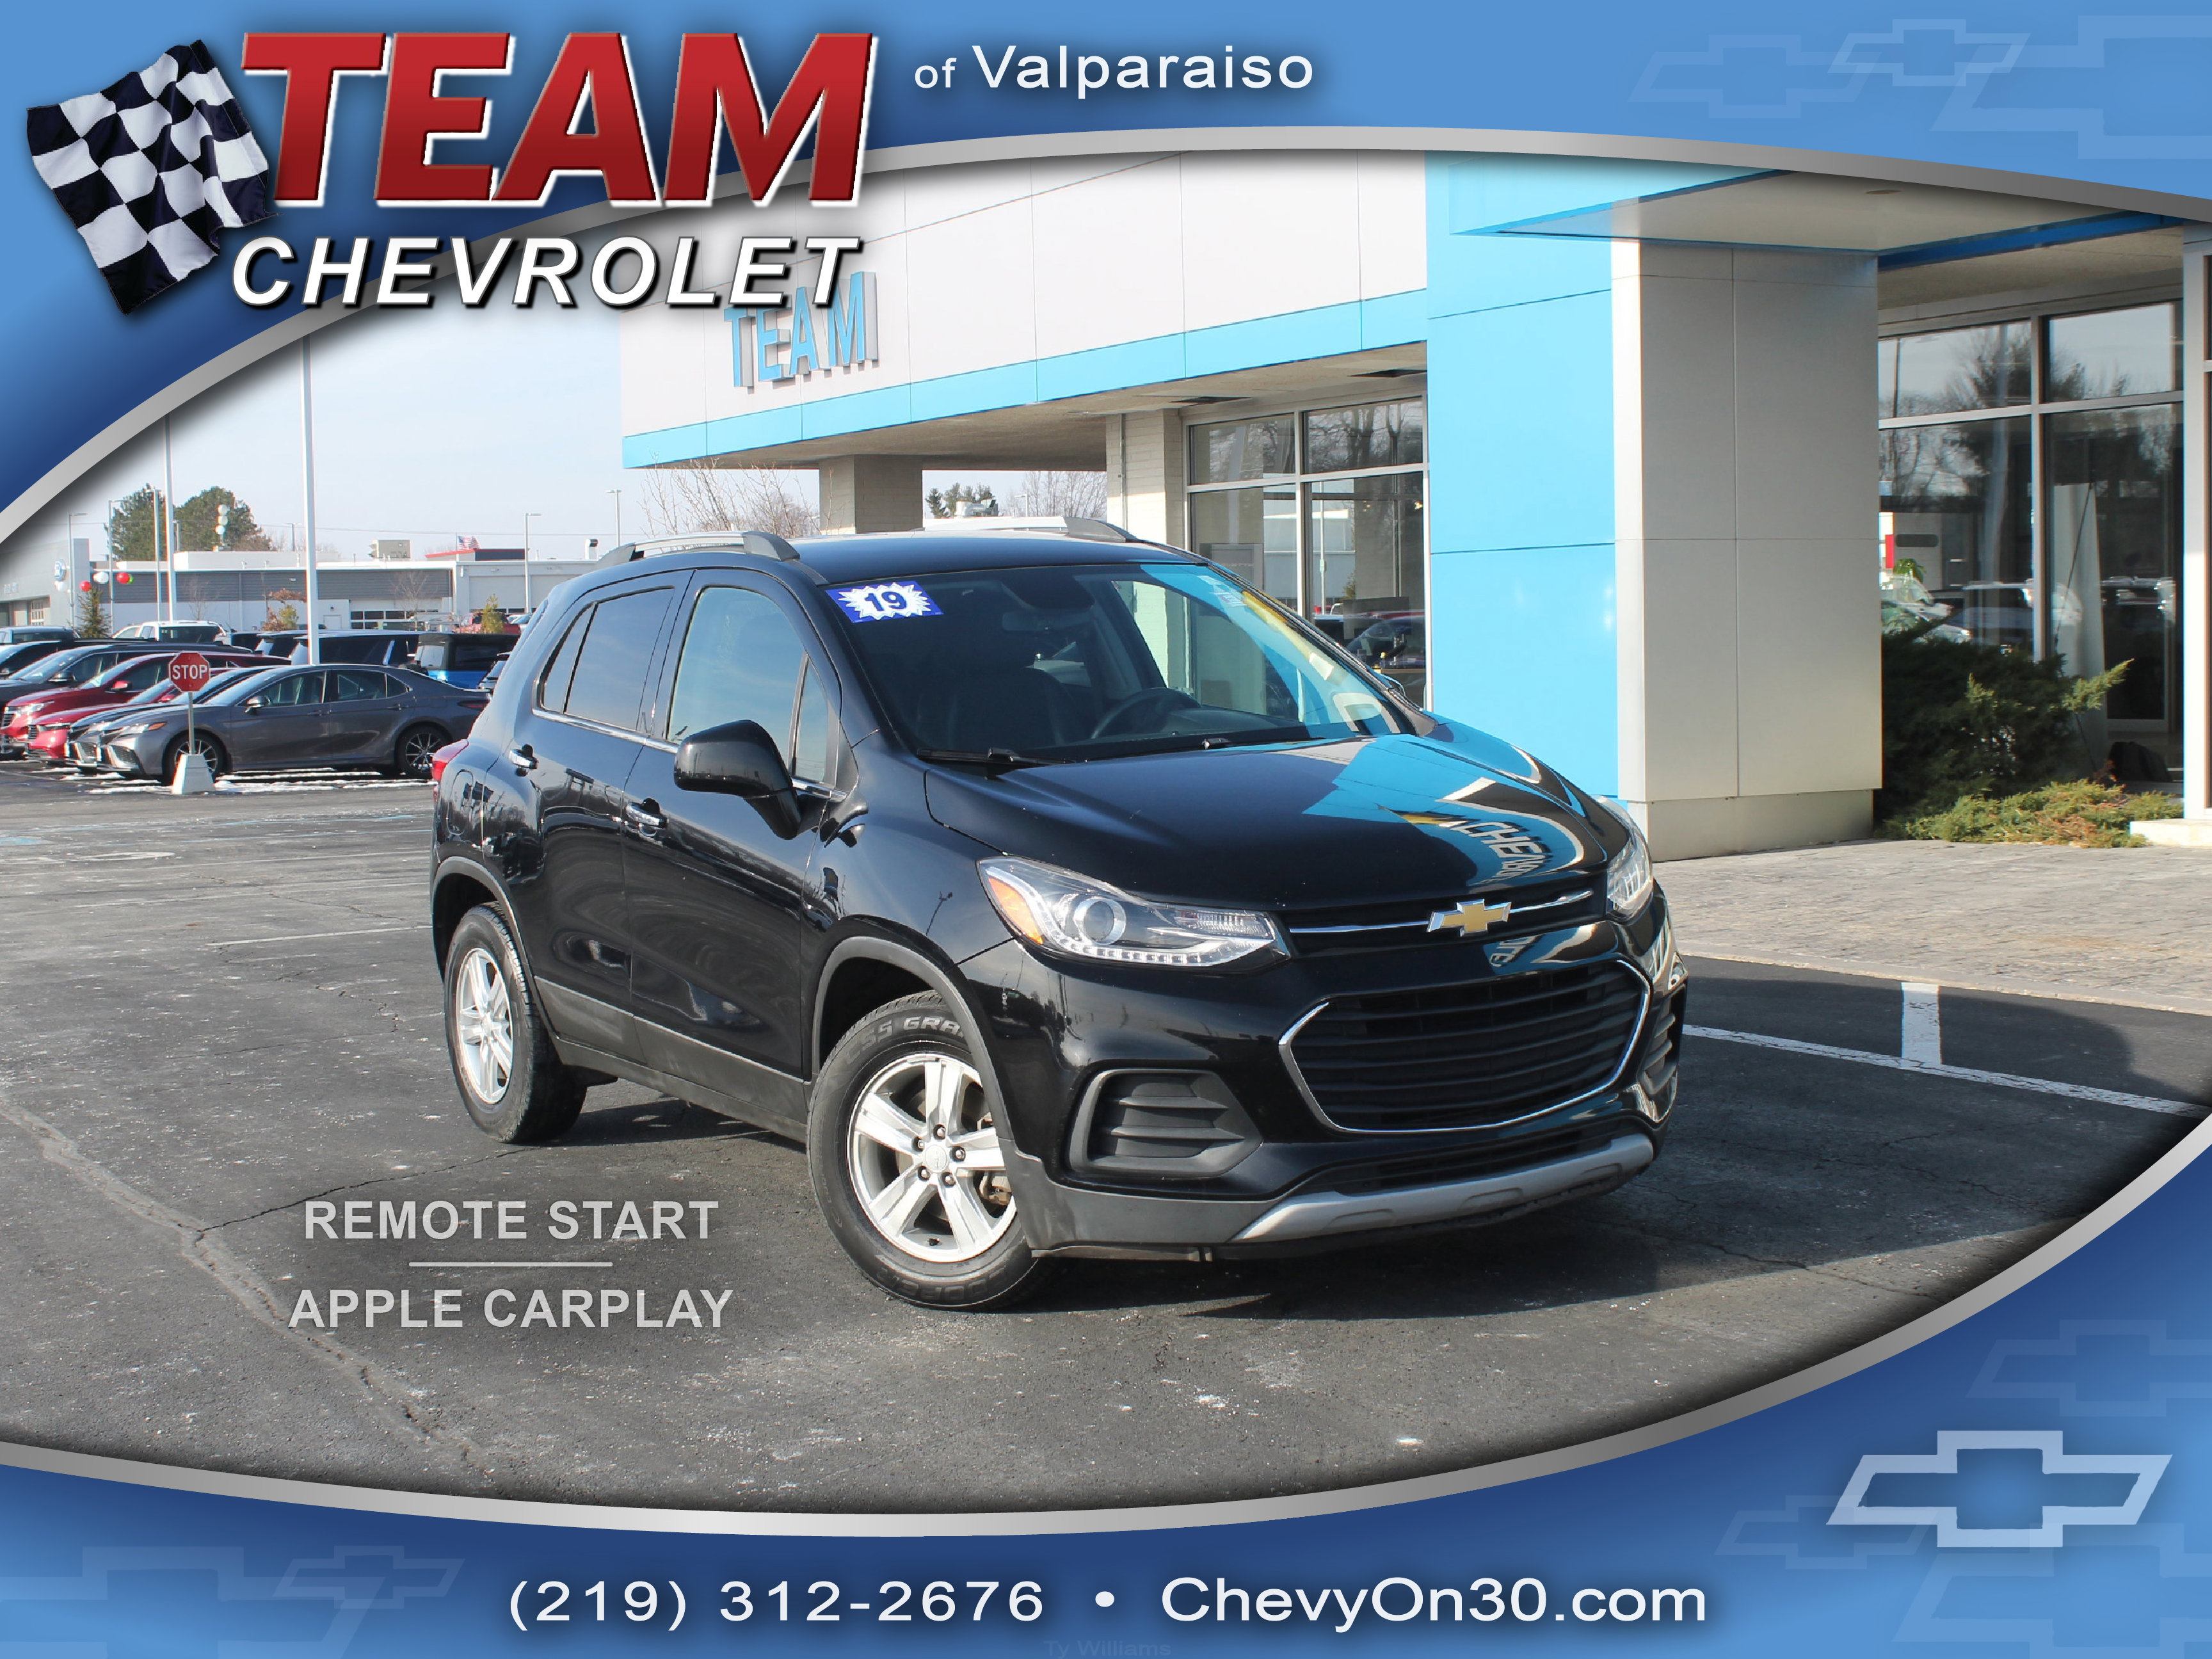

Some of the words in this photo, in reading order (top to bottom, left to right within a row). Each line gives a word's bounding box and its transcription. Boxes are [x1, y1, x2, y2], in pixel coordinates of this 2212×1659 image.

[724, 271, 878, 387] TEAM
[865, 591, 908, 612] 19
[172, 664, 208, 680] STOP
